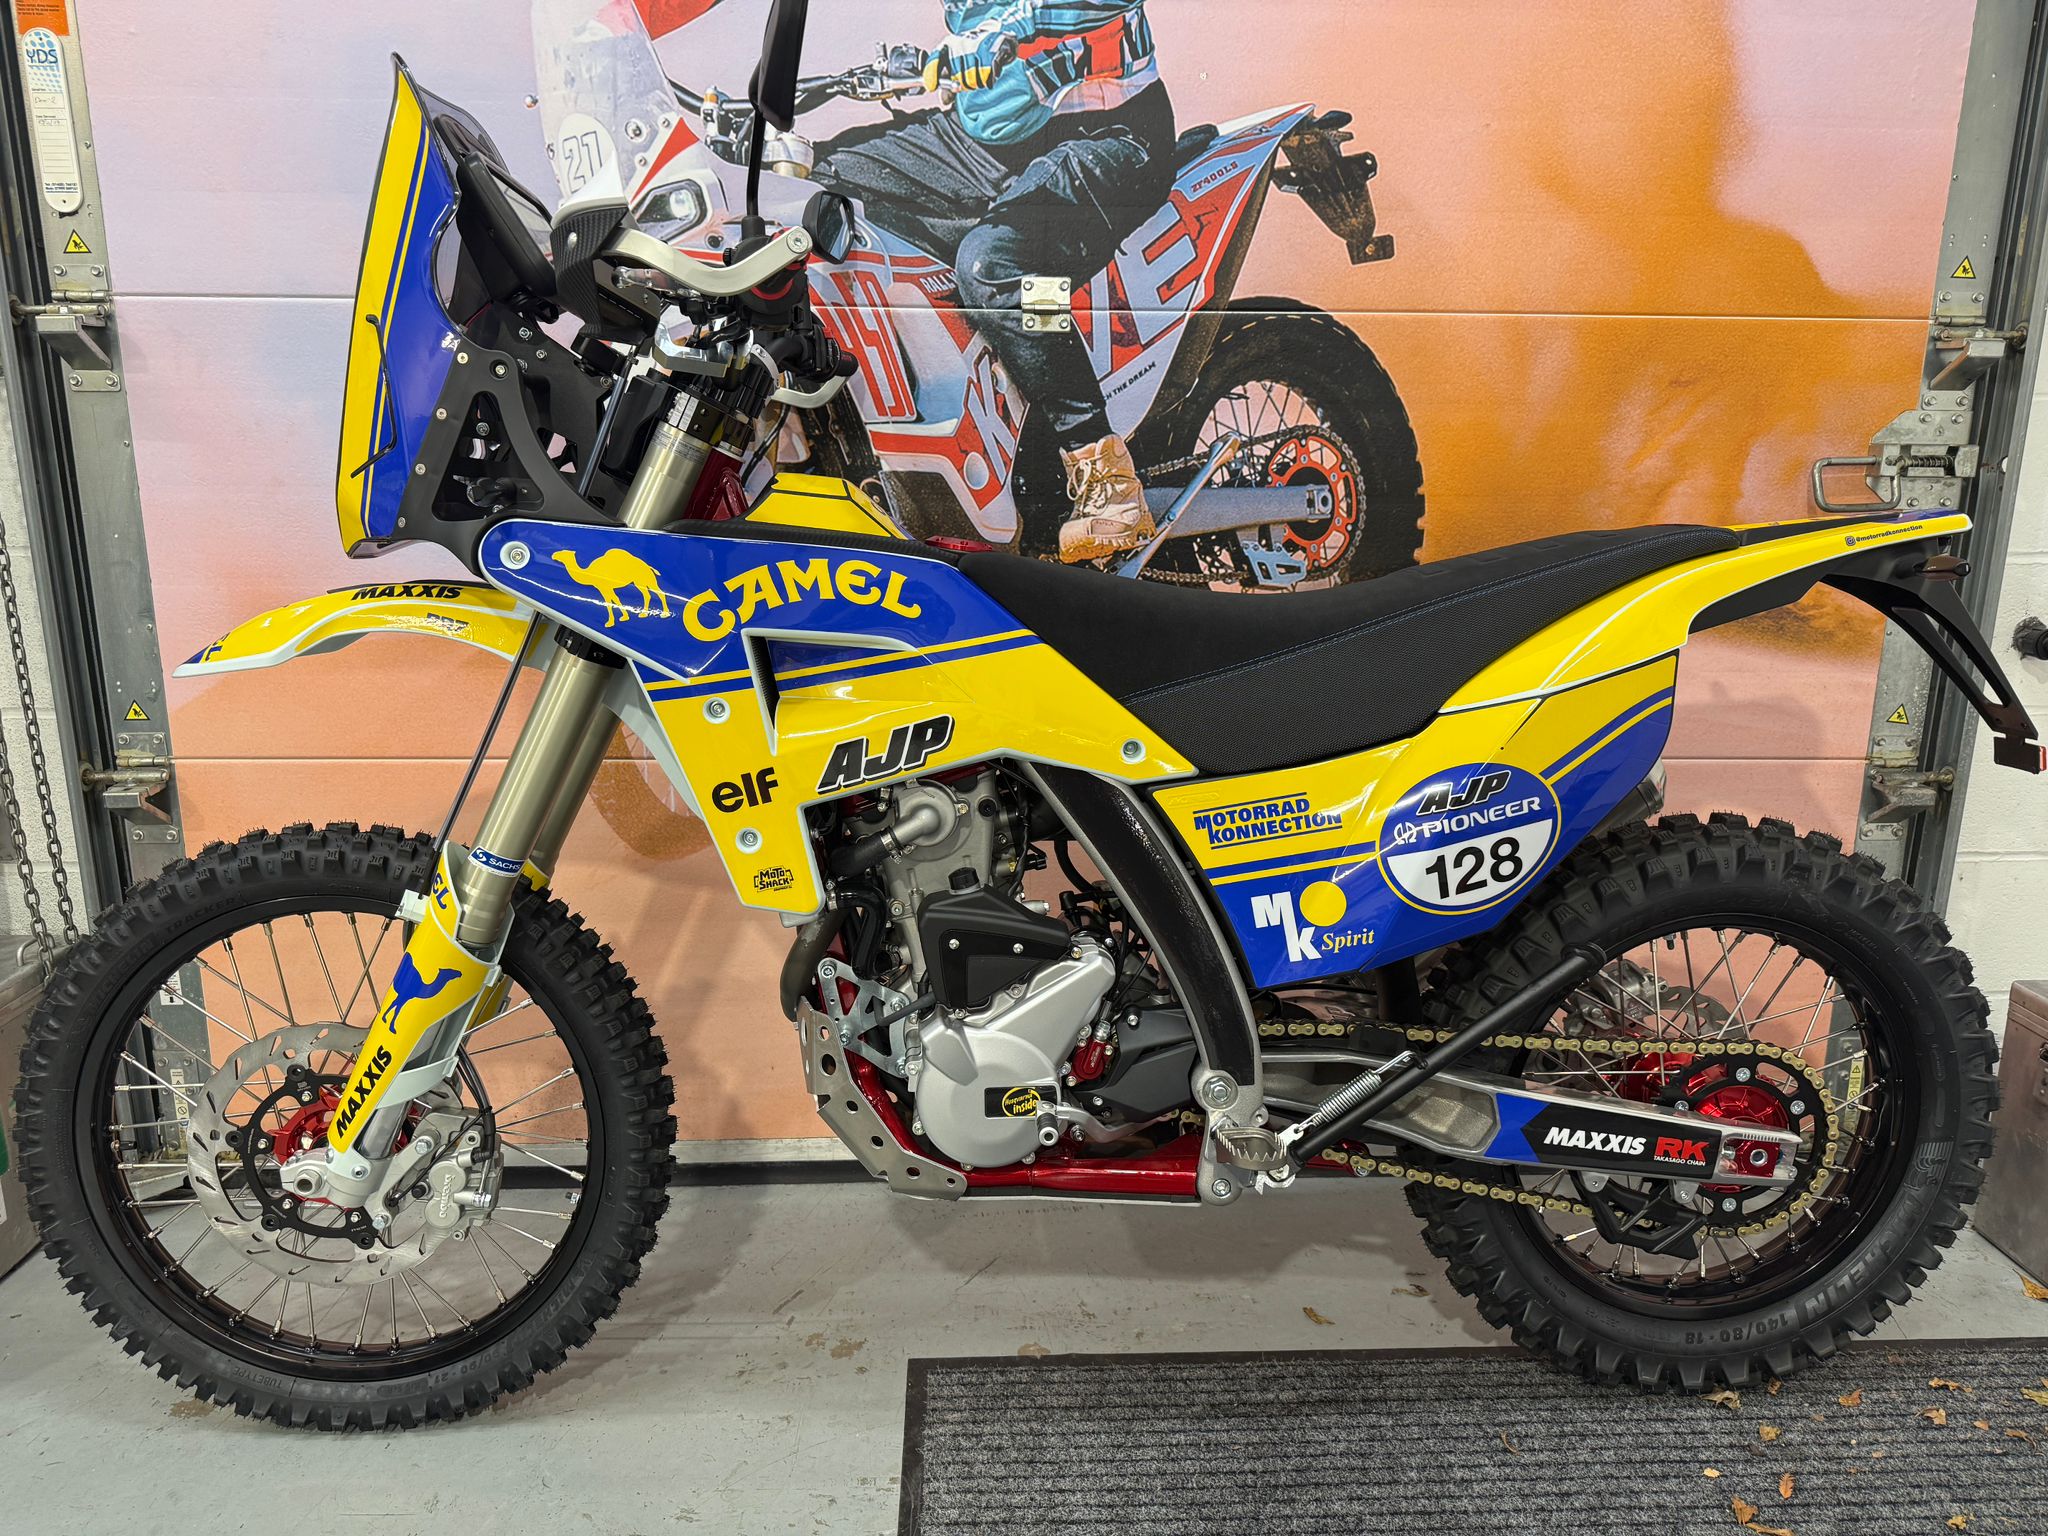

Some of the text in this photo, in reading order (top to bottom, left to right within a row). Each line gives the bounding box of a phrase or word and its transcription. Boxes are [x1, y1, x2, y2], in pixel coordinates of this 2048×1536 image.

[26, 49, 58, 64] YDS
[1191, 161, 1239, 192] ZF400LS
[919, 271, 958, 294] RALLY
[1112, 382, 1129, 396] THE
[1128, 360, 1157, 385] DREAM
[1855, 524, 1923, 542] @motorradkonnection
[351, 584, 464, 601] MAXXIS
[682, 558, 923, 642] CAMEL
[816, 714, 956, 796] AJP
[711, 767, 779, 814] elf
[1416, 770, 1511, 816] AJP
[1193, 799, 1310, 831] MOTORRAD
[1209, 812, 1342, 845] KONNECTION
[1422, 797, 1541, 839] PIONEER
[488, 857, 521, 871] SACHS
[1425, 837, 1523, 900] 128
[758, 877, 790, 890] SHACK
[1321, 928, 1375, 954] Spirit
[336, 1045, 392, 1139] MAXXIS
[1543, 1126, 1710, 1162] MAXXIS RK
[1653, 1155, 1706, 1167] TAKASAGO CHAIN
